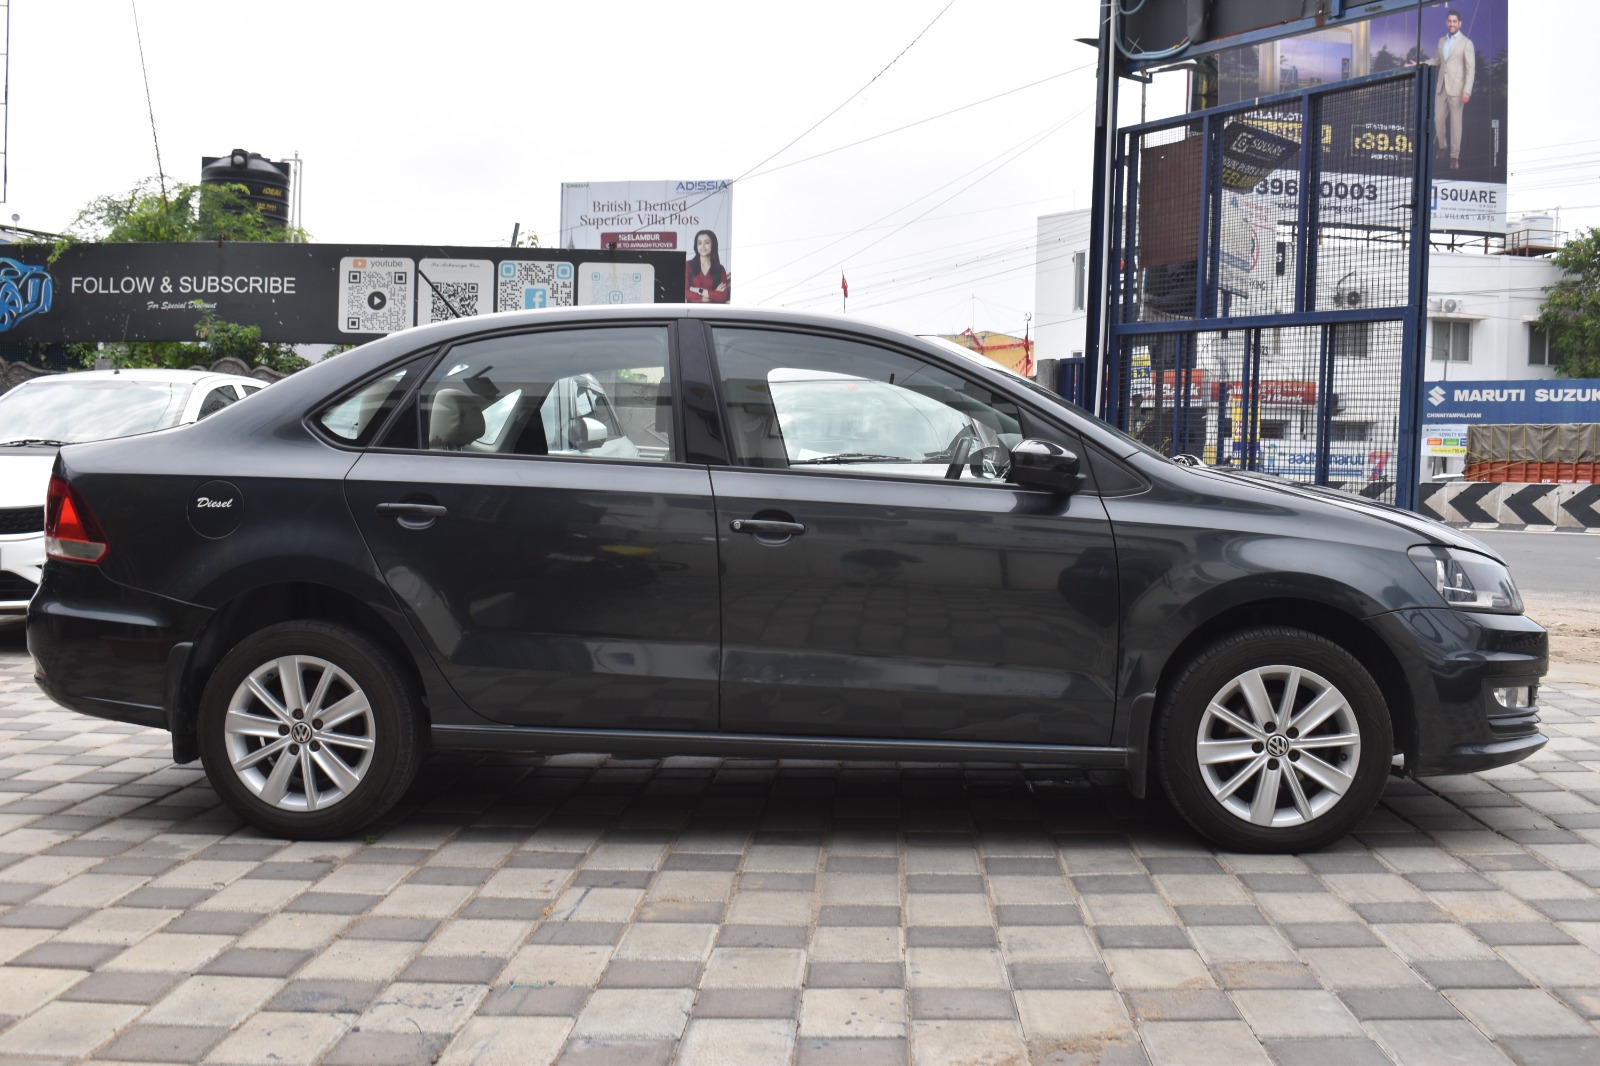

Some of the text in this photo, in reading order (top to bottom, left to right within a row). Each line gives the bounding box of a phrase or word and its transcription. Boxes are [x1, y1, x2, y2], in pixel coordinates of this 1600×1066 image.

[676, 180, 728, 191] ADISSIA
[1440, 188, 1497, 204] SQUARE
[592, 200, 688, 212] British Themed
[579, 213, 700, 229] Superior Villa Plots
[618, 233, 661, 241] NEELAMBUR
[370, 260, 403, 268] youtube
[71, 276, 296, 294] FOLLOW & SUBSCRIBE
[146, 301, 159, 311] For
[160, 301, 187, 311] Special
[1453, 389, 1600, 402] MARUTI SUZUK
[197, 496, 234, 508] Diesel
